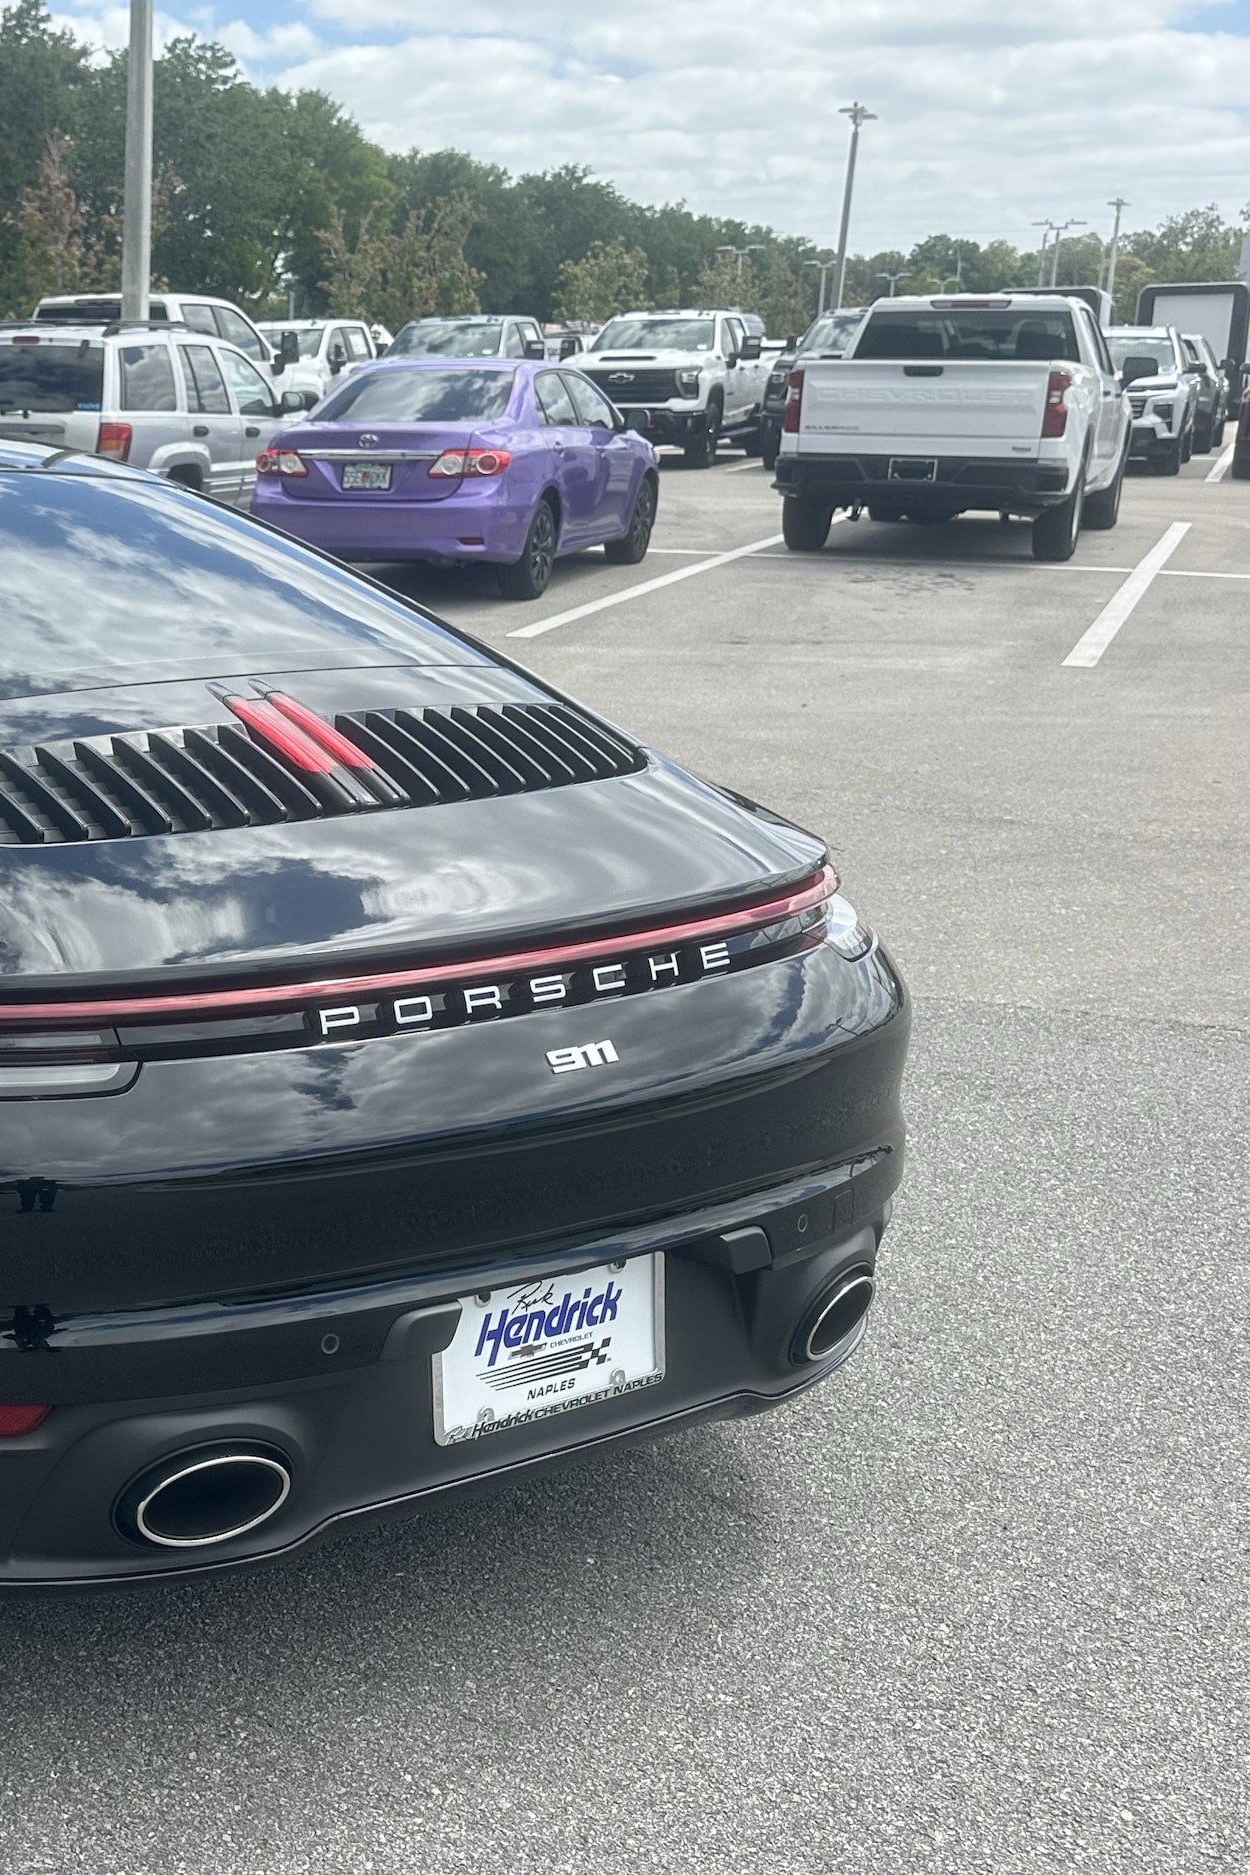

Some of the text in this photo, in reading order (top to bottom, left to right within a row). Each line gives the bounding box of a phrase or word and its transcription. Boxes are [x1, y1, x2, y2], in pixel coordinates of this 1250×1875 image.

[817, 389, 1029, 403] CHEVROLET
[319, 942, 731, 1035] PORSCHE
[546, 1039, 620, 1074] 911
[507, 1280, 555, 1315] Rick
[474, 1281, 623, 1367] Hendrick
[550, 1331, 594, 1348] CHEVROLET
[471, 1409, 535, 1440] Hendrick
[534, 1388, 611, 1419] CHEVROLET
[613, 1372, 663, 1396] NAPLES
[527, 1378, 576, 1401] NAPLES
